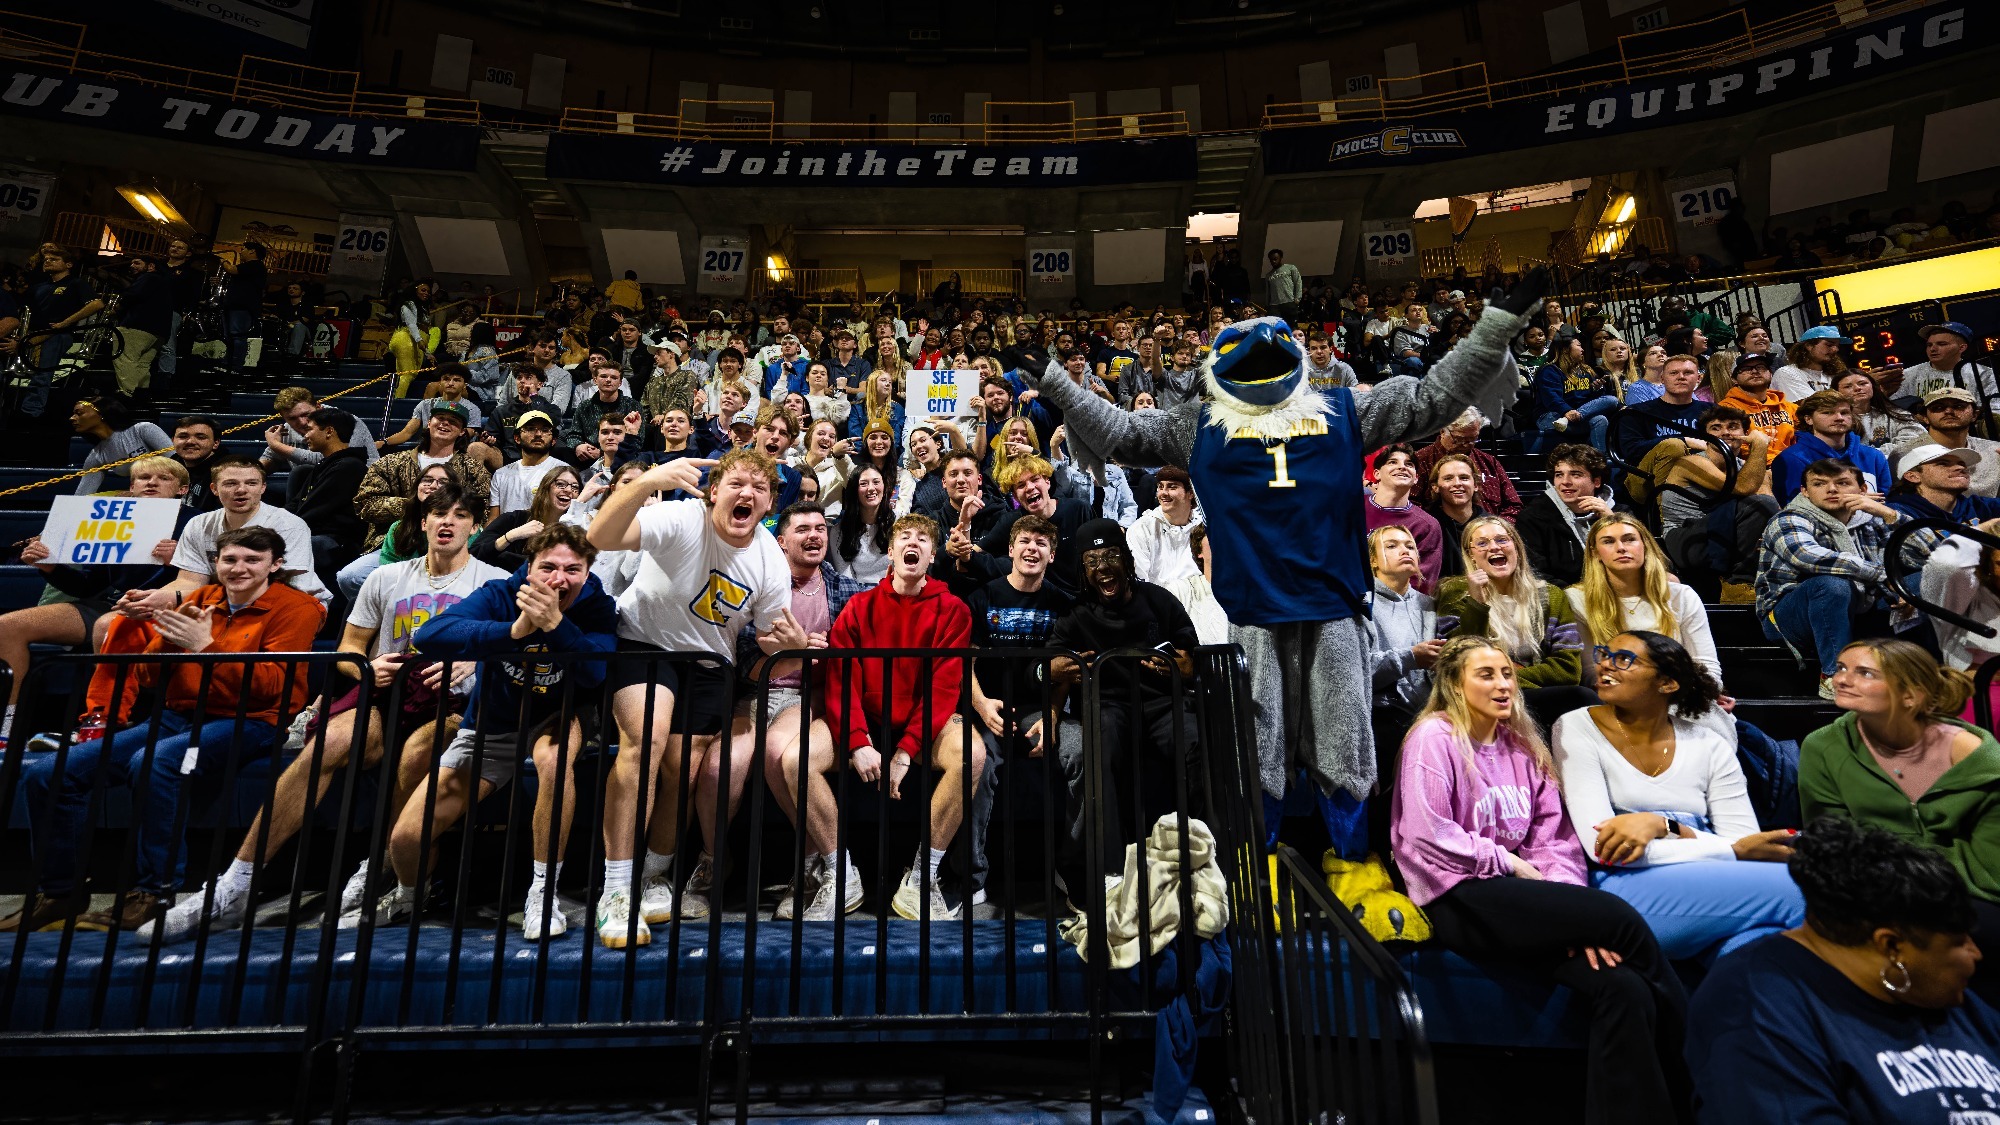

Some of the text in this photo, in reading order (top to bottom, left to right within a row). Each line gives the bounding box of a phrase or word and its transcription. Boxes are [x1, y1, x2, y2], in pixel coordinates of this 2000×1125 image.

[207, 3, 262, 28] Optics
[1637, 10, 1662, 31] 311
[487, 69, 513, 85] 306
[1544, 8, 1965, 134] EQUIPPING
[1349, 76, 1370, 92] 310
[1, 73, 405, 156] UB TODAY
[1336, 136, 1379, 155] MOCS
[1411, 131, 1458, 144] CLUB
[659, 146, 1080, 177] #JointheTeam
[1680, 188, 1731, 217] 210
[340, 228, 388, 253] 206
[1369, 232, 1411, 256] 209
[704, 250, 744, 272] 207
[1032, 251, 1070, 272] 208
[932, 370, 956, 385] SEE
[927, 384, 958, 399] MOC
[927, 398, 957, 413] CITY
[1265, 442, 1297, 488] 1
[90, 499, 137, 520] SEE
[75, 520, 135, 541] MOC
[71, 542, 132, 563] CITY
